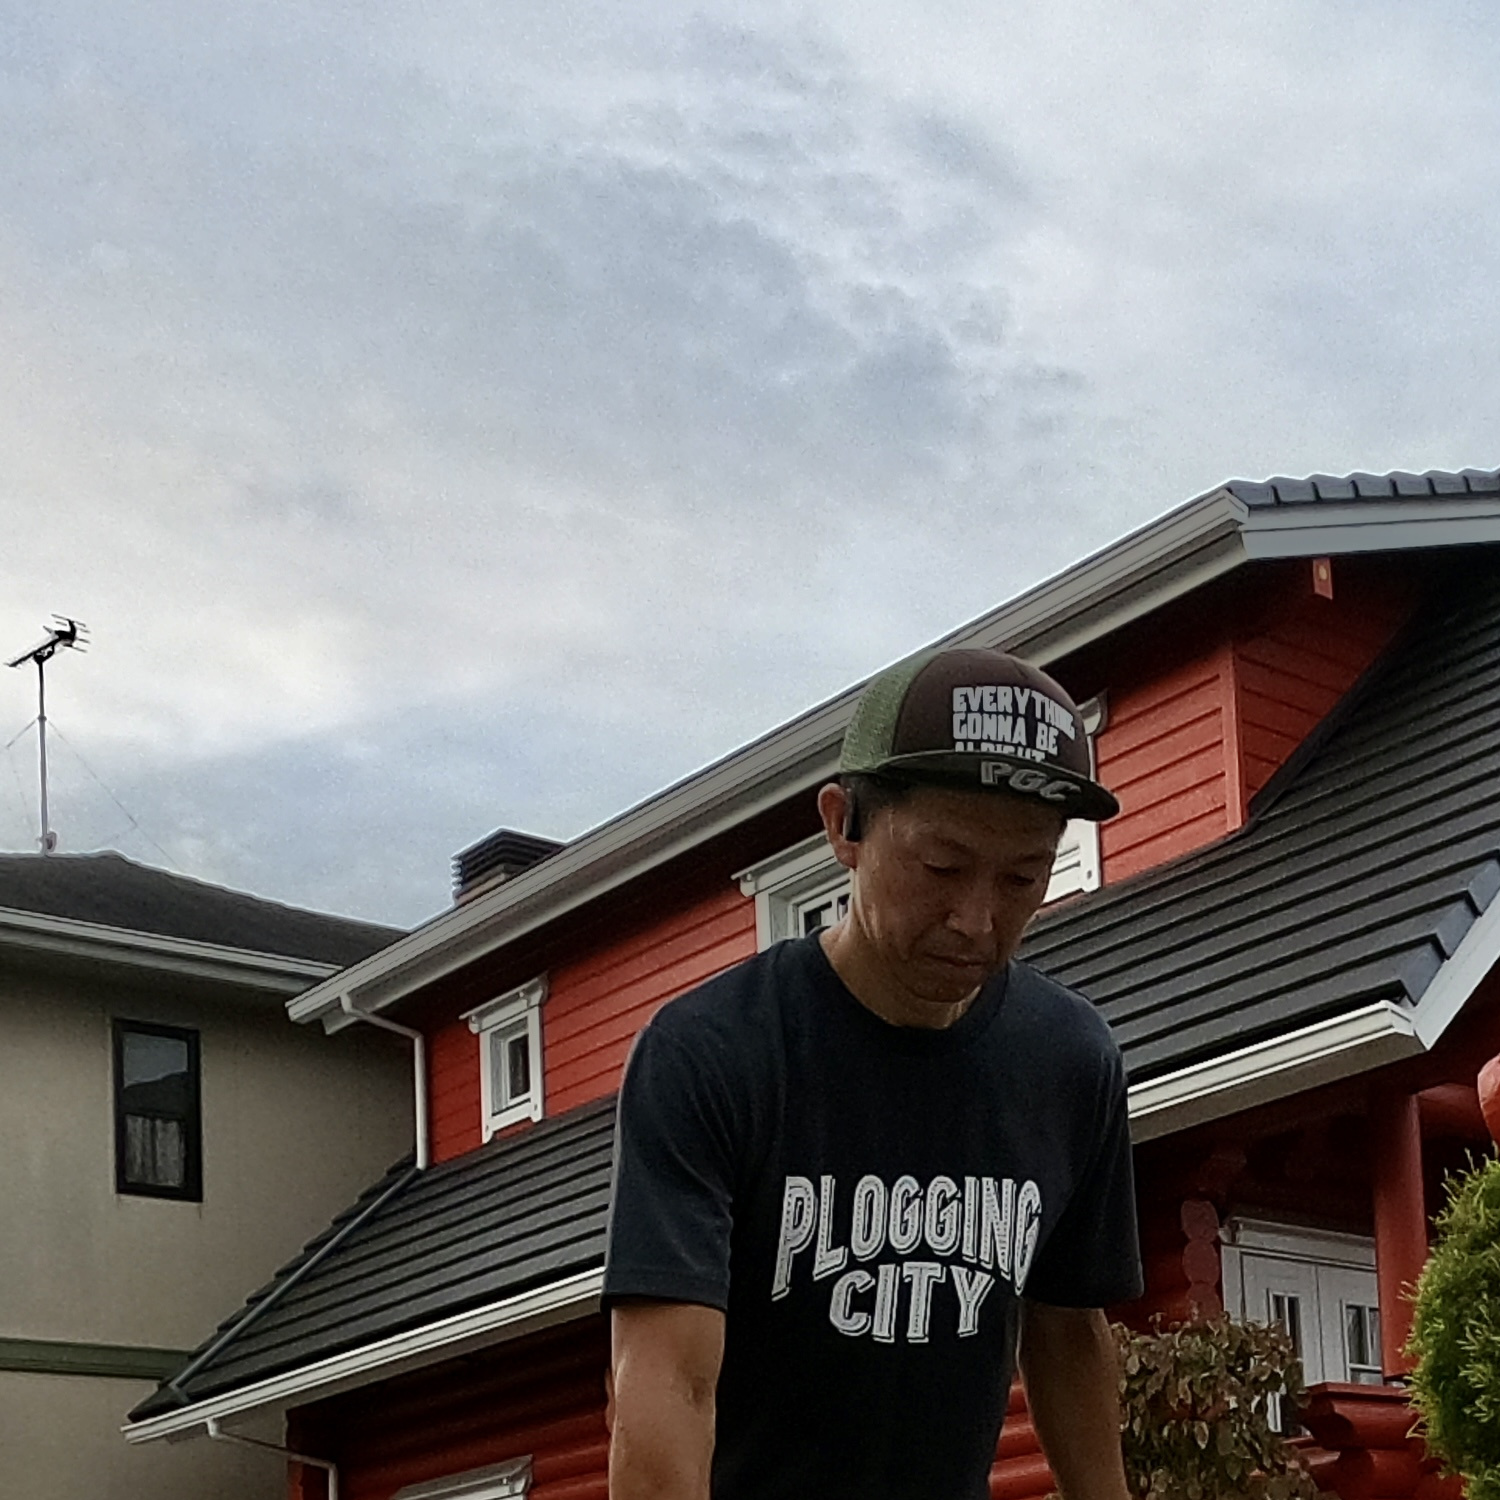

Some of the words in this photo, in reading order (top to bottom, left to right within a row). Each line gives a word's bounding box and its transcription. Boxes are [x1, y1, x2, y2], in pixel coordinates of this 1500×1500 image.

[953, 712, 1027, 746] GONNA
[1036, 721, 1060, 756] BE
[980, 761, 1081, 801] PGC
[771, 1174, 1042, 1302] PLOGGING
[829, 1261, 996, 1343] CITY
